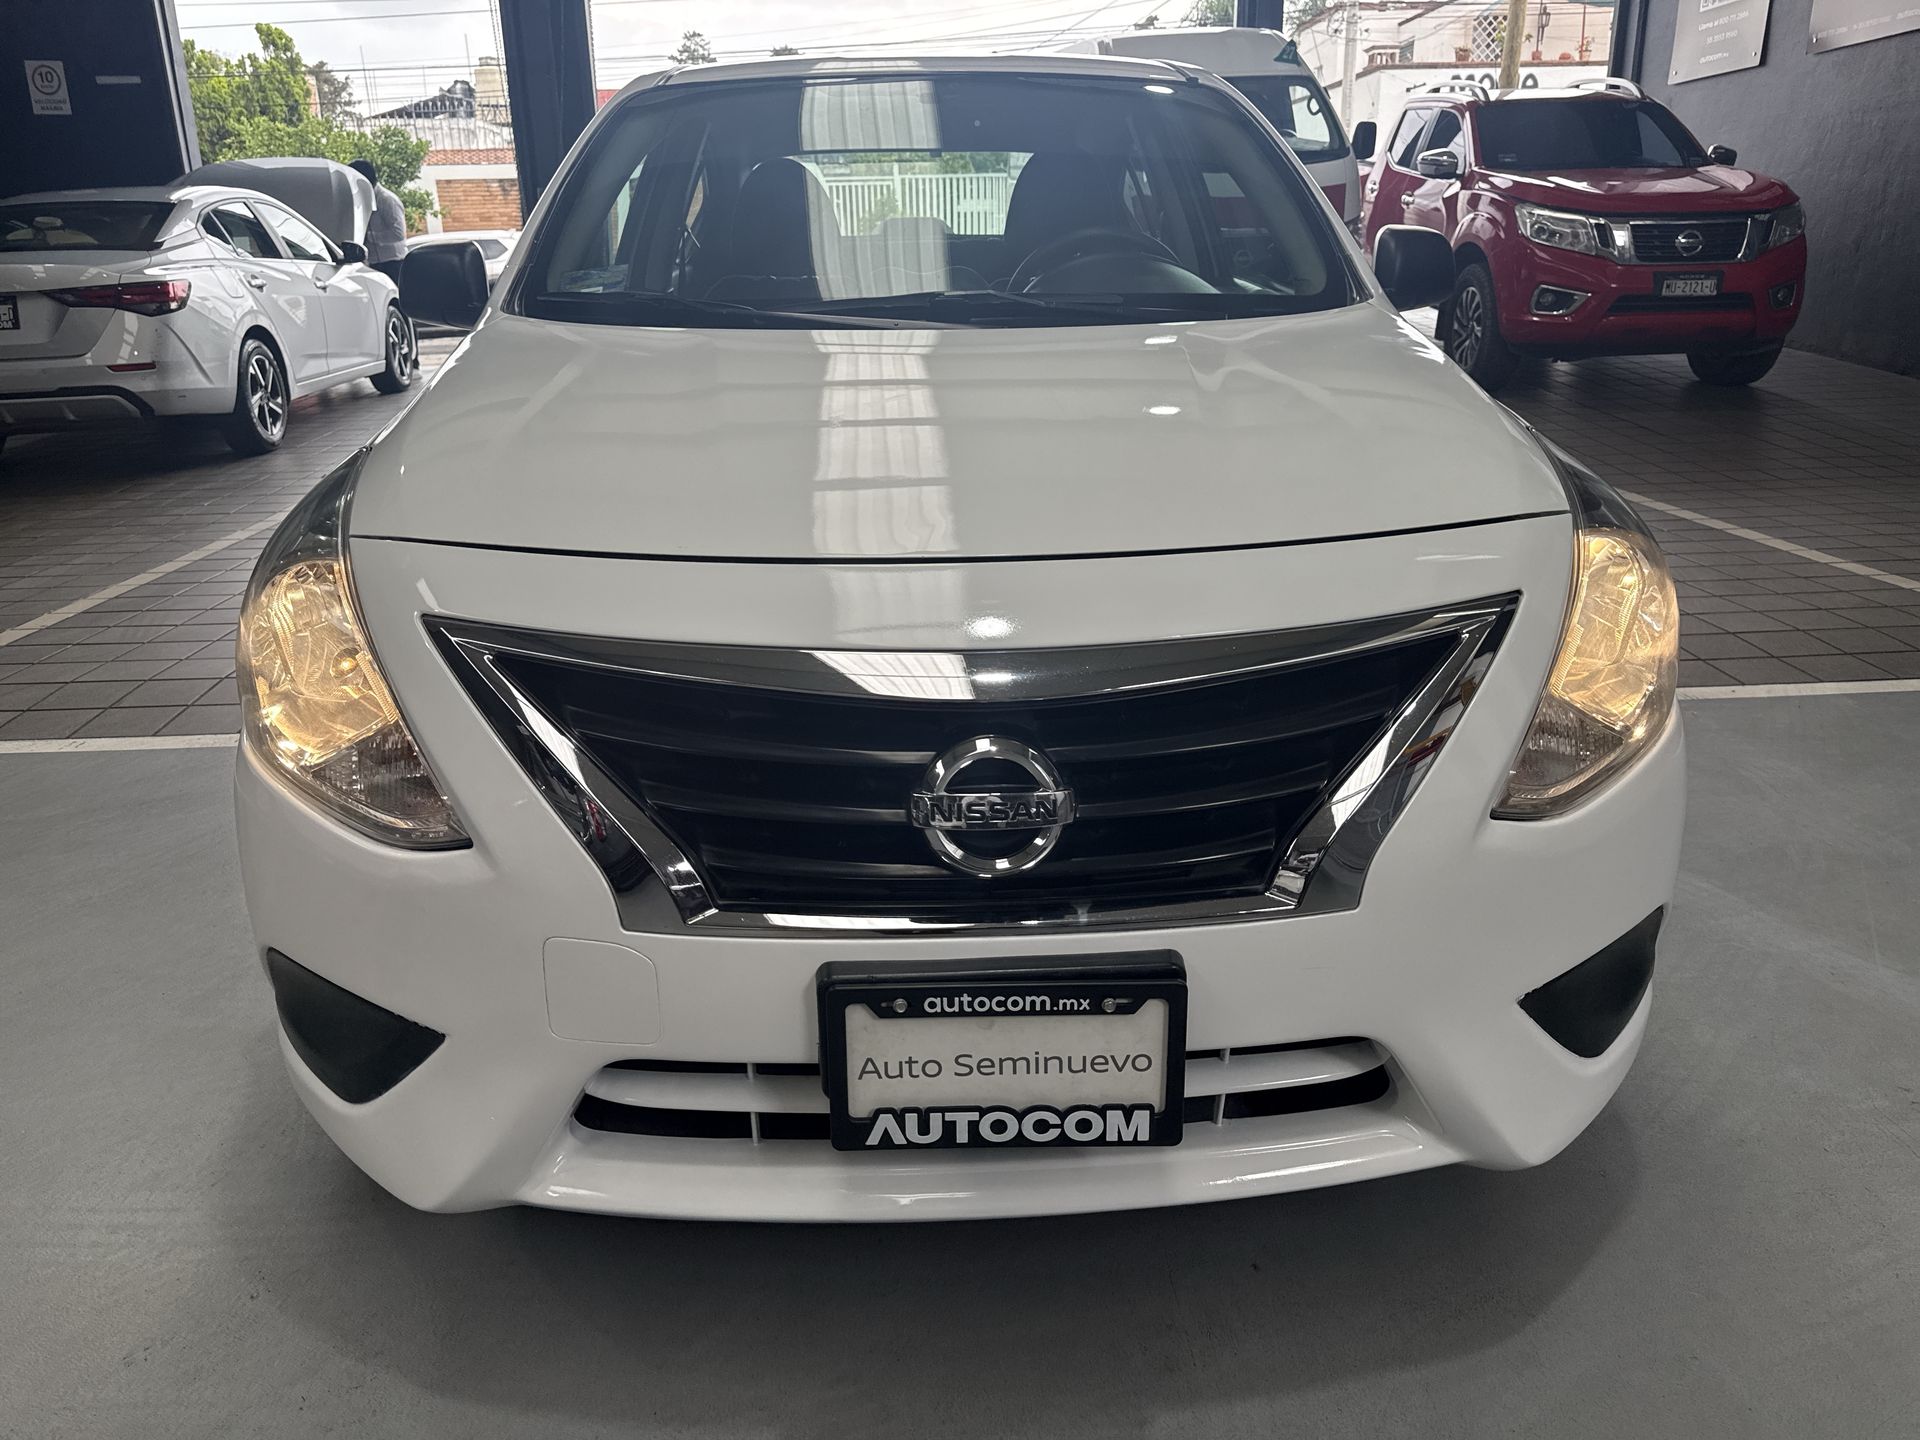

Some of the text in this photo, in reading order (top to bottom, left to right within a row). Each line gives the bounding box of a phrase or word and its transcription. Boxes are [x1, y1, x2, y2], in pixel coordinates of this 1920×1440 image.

[38, 70, 54, 83] 10
[930, 799, 1058, 822] NISSAN
[923, 993, 1091, 1013] autocom.mx
[858, 1052, 1153, 1080] Auto Seminuevo
[865, 1110, 1150, 1146] AUTOCOM
